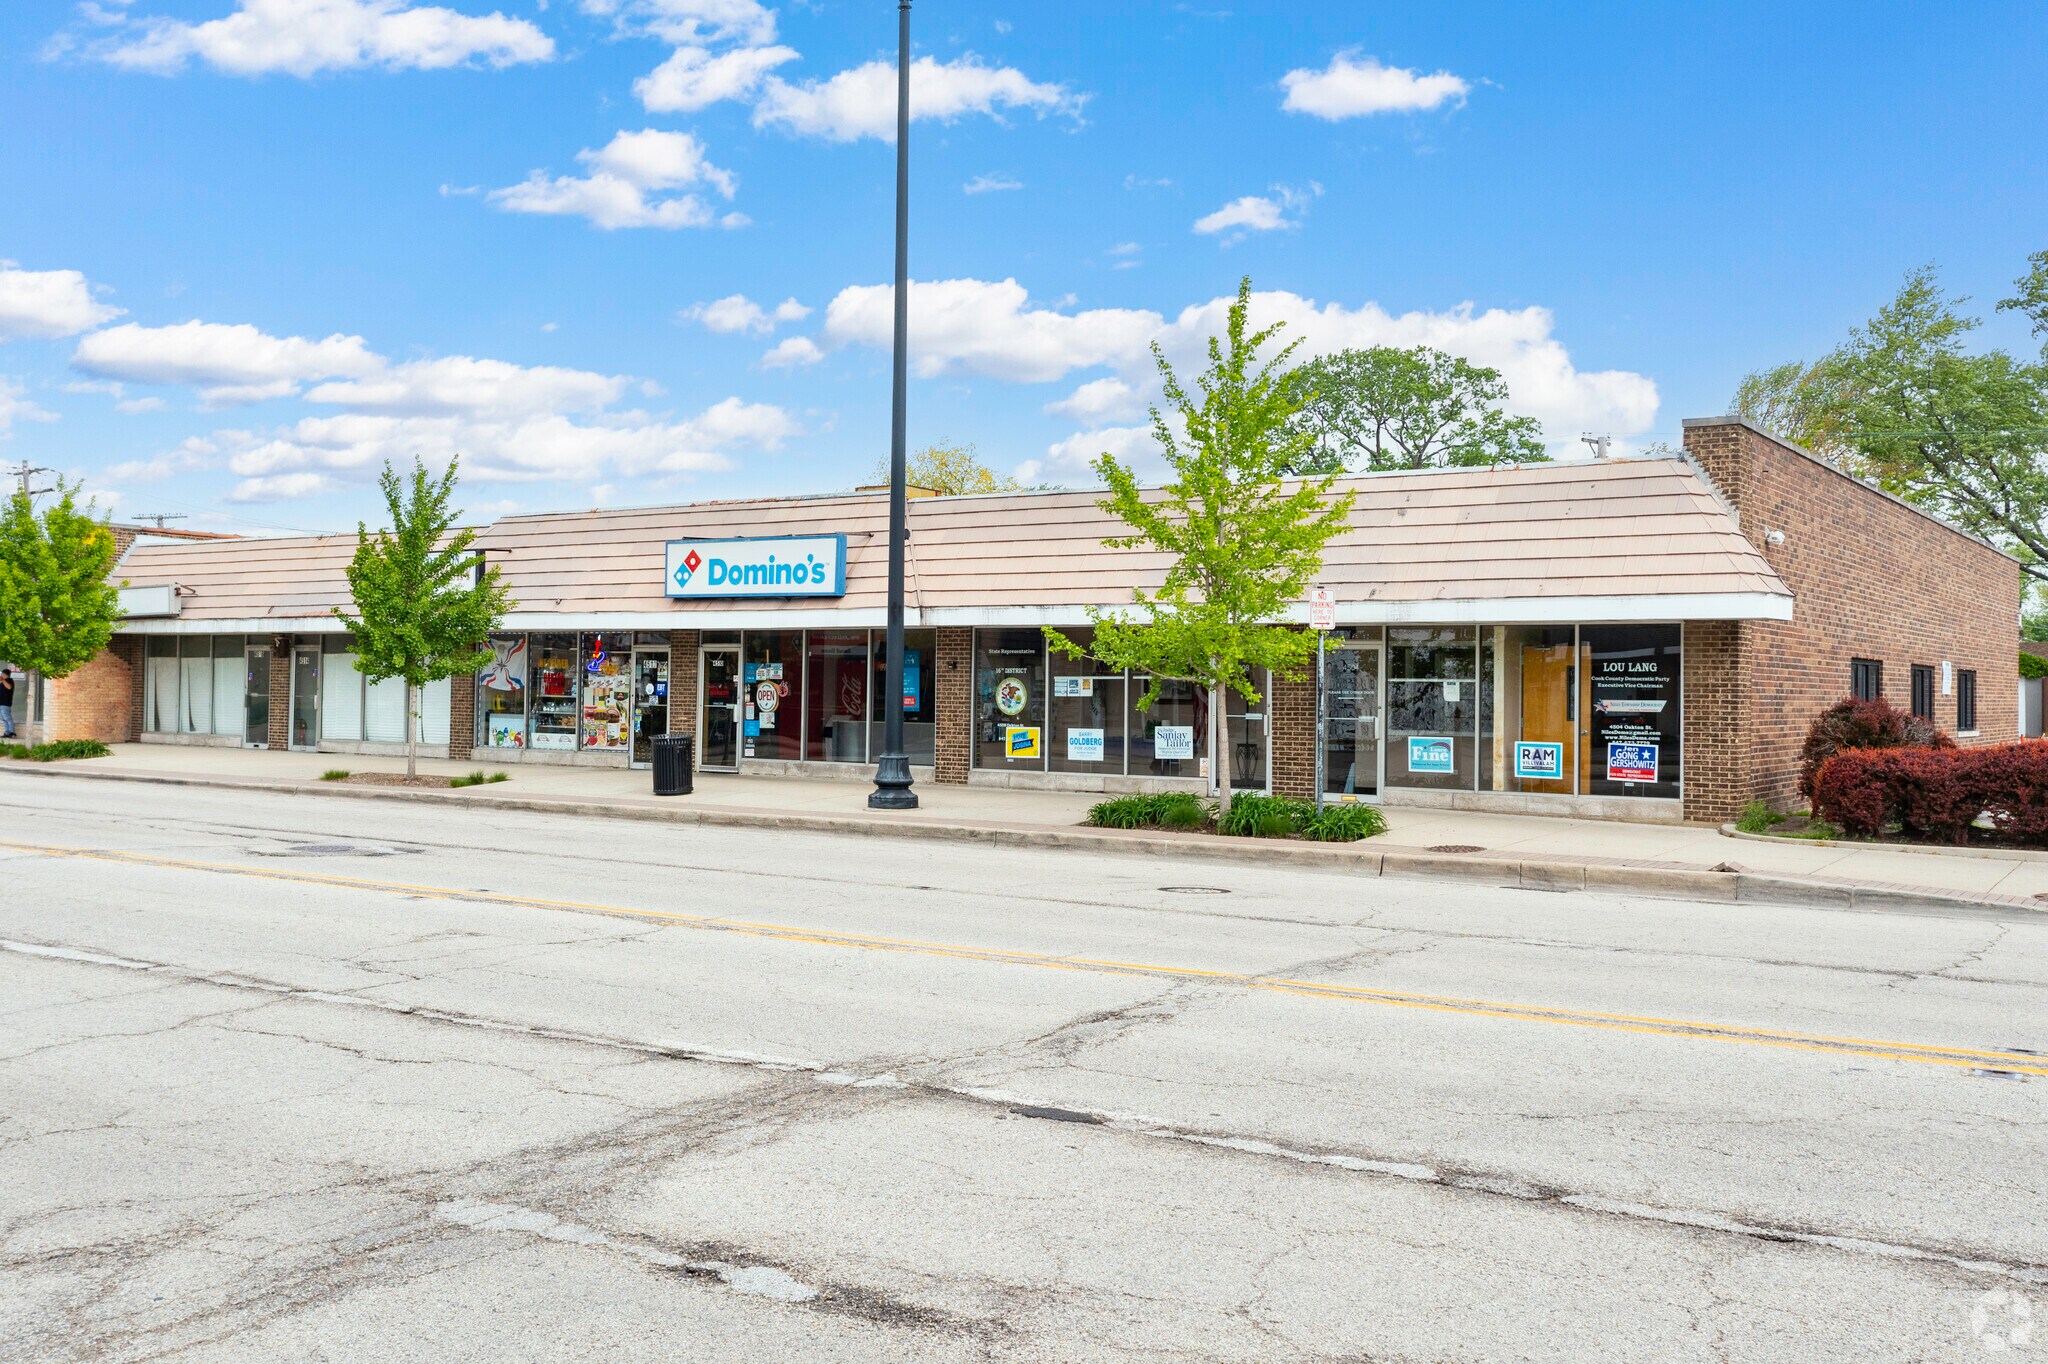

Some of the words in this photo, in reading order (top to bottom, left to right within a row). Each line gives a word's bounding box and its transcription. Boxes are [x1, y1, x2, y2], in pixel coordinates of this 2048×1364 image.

[708, 553, 826, 586] Domino's
[1317, 592, 1327, 600] NO
[1311, 601, 1334, 609] PARKING
[1603, 662, 1625, 672] LOU
[1628, 662, 1658, 672] LANG
[758, 690, 775, 701] OPEN
[1157, 731, 1187, 741] Sanjay
[1070, 737, 1103, 746] GOLDBERG
[1165, 738, 1191, 748] Tailor
[1411, 746, 1449, 761] Fine
[1522, 748, 1555, 761] RAM
[1615, 749, 1639, 760] GONG
[1610, 757, 1655, 769] GERSHOWITZ
